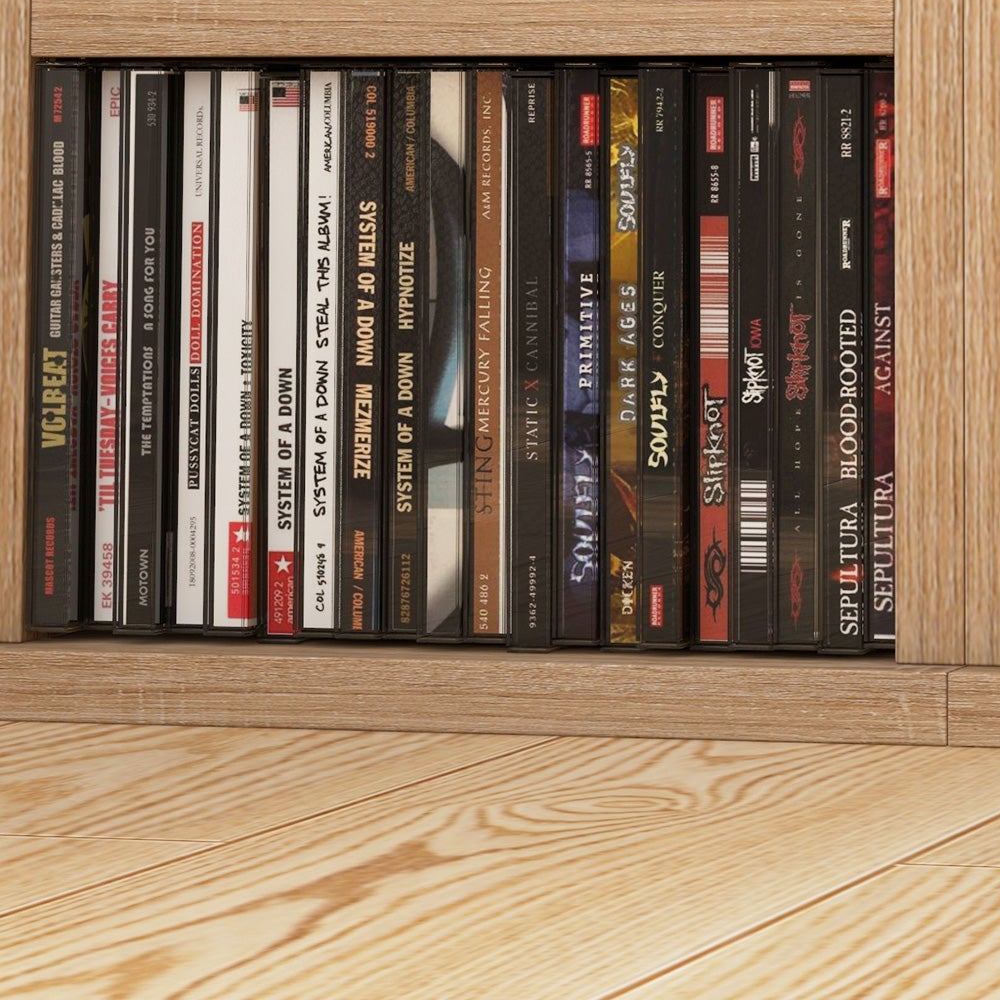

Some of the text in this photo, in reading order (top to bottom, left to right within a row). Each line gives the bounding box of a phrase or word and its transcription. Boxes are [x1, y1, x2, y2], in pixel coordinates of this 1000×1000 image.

[482, 92, 492, 219] A&M RECORDS, INC.
[319, 195, 331, 251] ALBUM!
[317, 257, 330, 291] THIS
[317, 298, 329, 348] STEAL
[478, 267, 492, 432] MERCURY FALLING
[578, 273, 593, 388] PRIMITIVE
[316, 360, 328, 407] DOWN
[398, 242, 414, 512] SYSTEM OF A DOWN HYPNOTIZE
[316, 426, 327, 444] OF
[840, 309, 858, 635] SEPULTURA BLOOD-ROOTED
[874, 302, 894, 612] SEPULTURA AGAINST
[314, 451, 326, 516] SYSTEM
